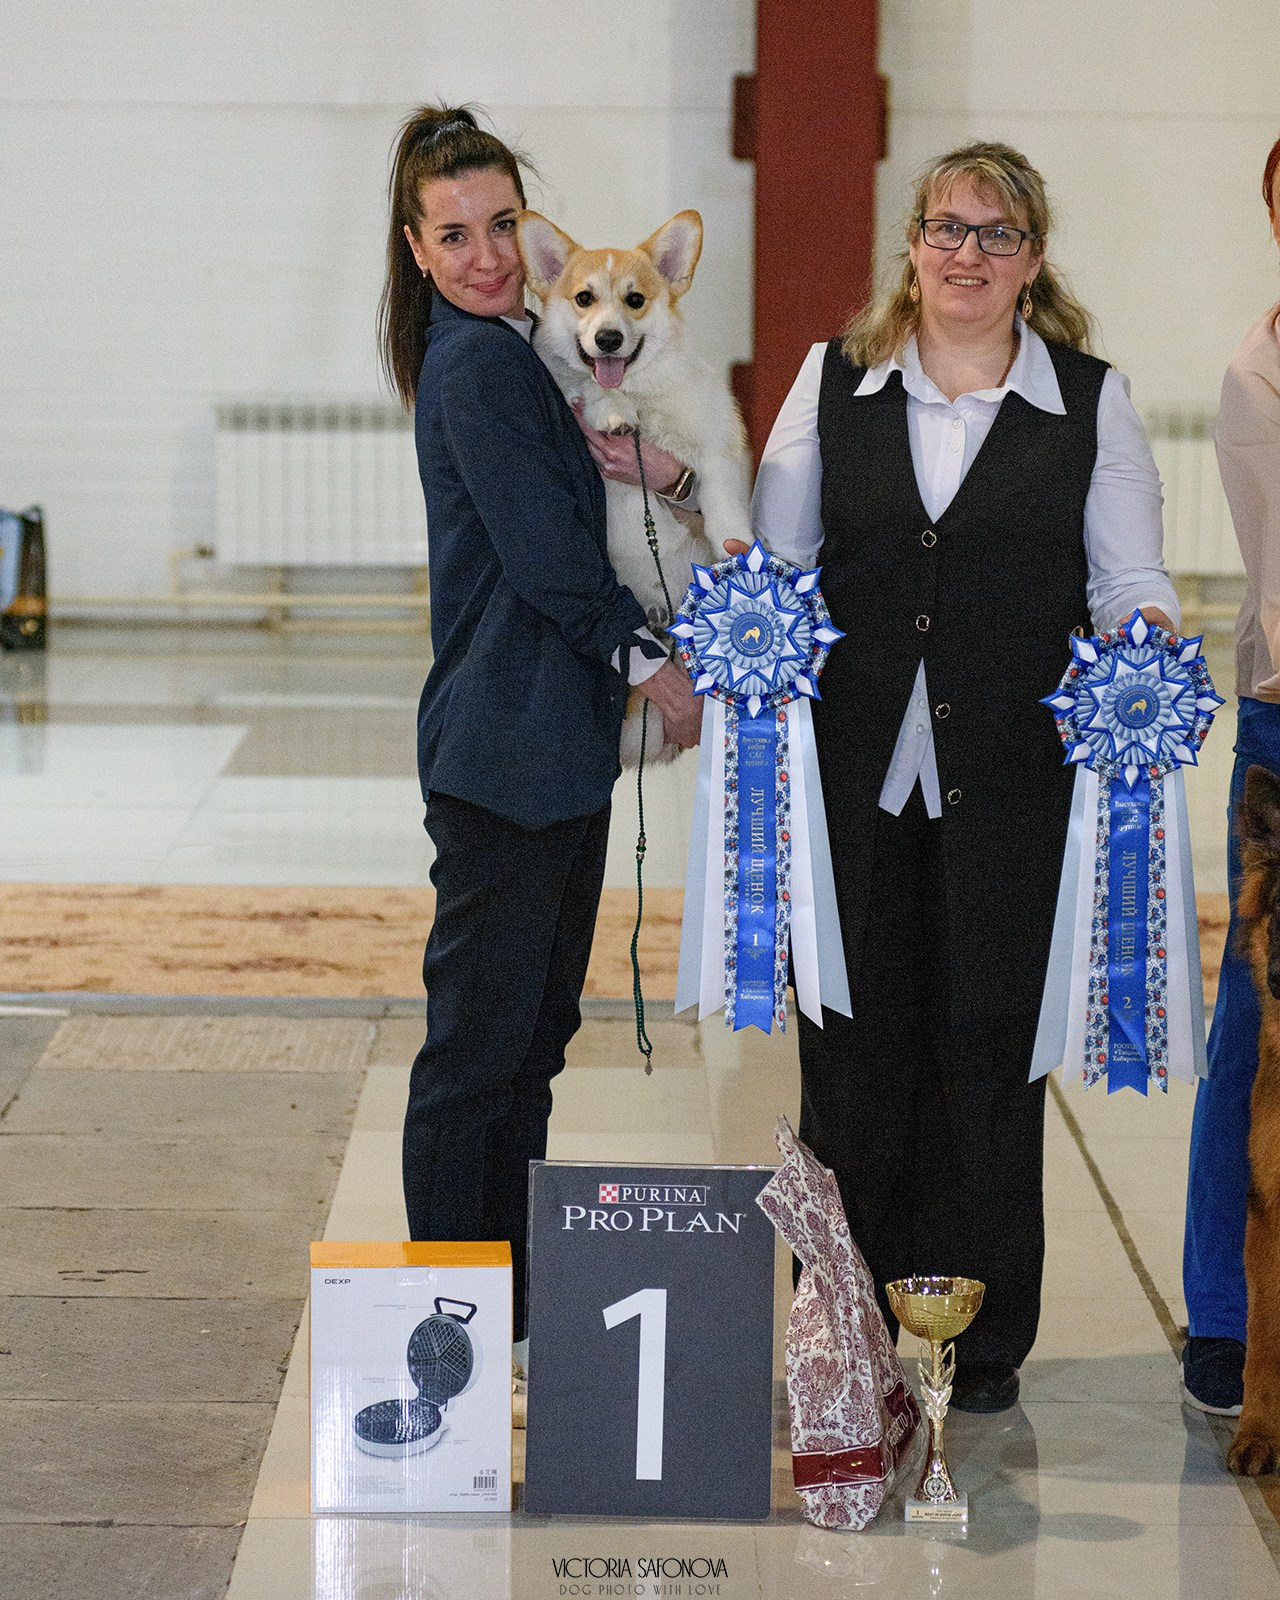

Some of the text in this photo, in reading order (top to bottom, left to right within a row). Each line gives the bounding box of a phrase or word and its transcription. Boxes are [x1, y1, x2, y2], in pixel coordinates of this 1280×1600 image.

[750, 787, 768, 914] ЛУЧШИЙ ЩЕНОК
[752, 933, 759, 946] 1
[1120, 850, 1138, 977] ЛУЧШИЙ ЩЕНОК
[1123, 996, 1132, 1009] 2
[621, 1187, 703, 1204] PURINA
[602, 1288, 667, 1481] 1
